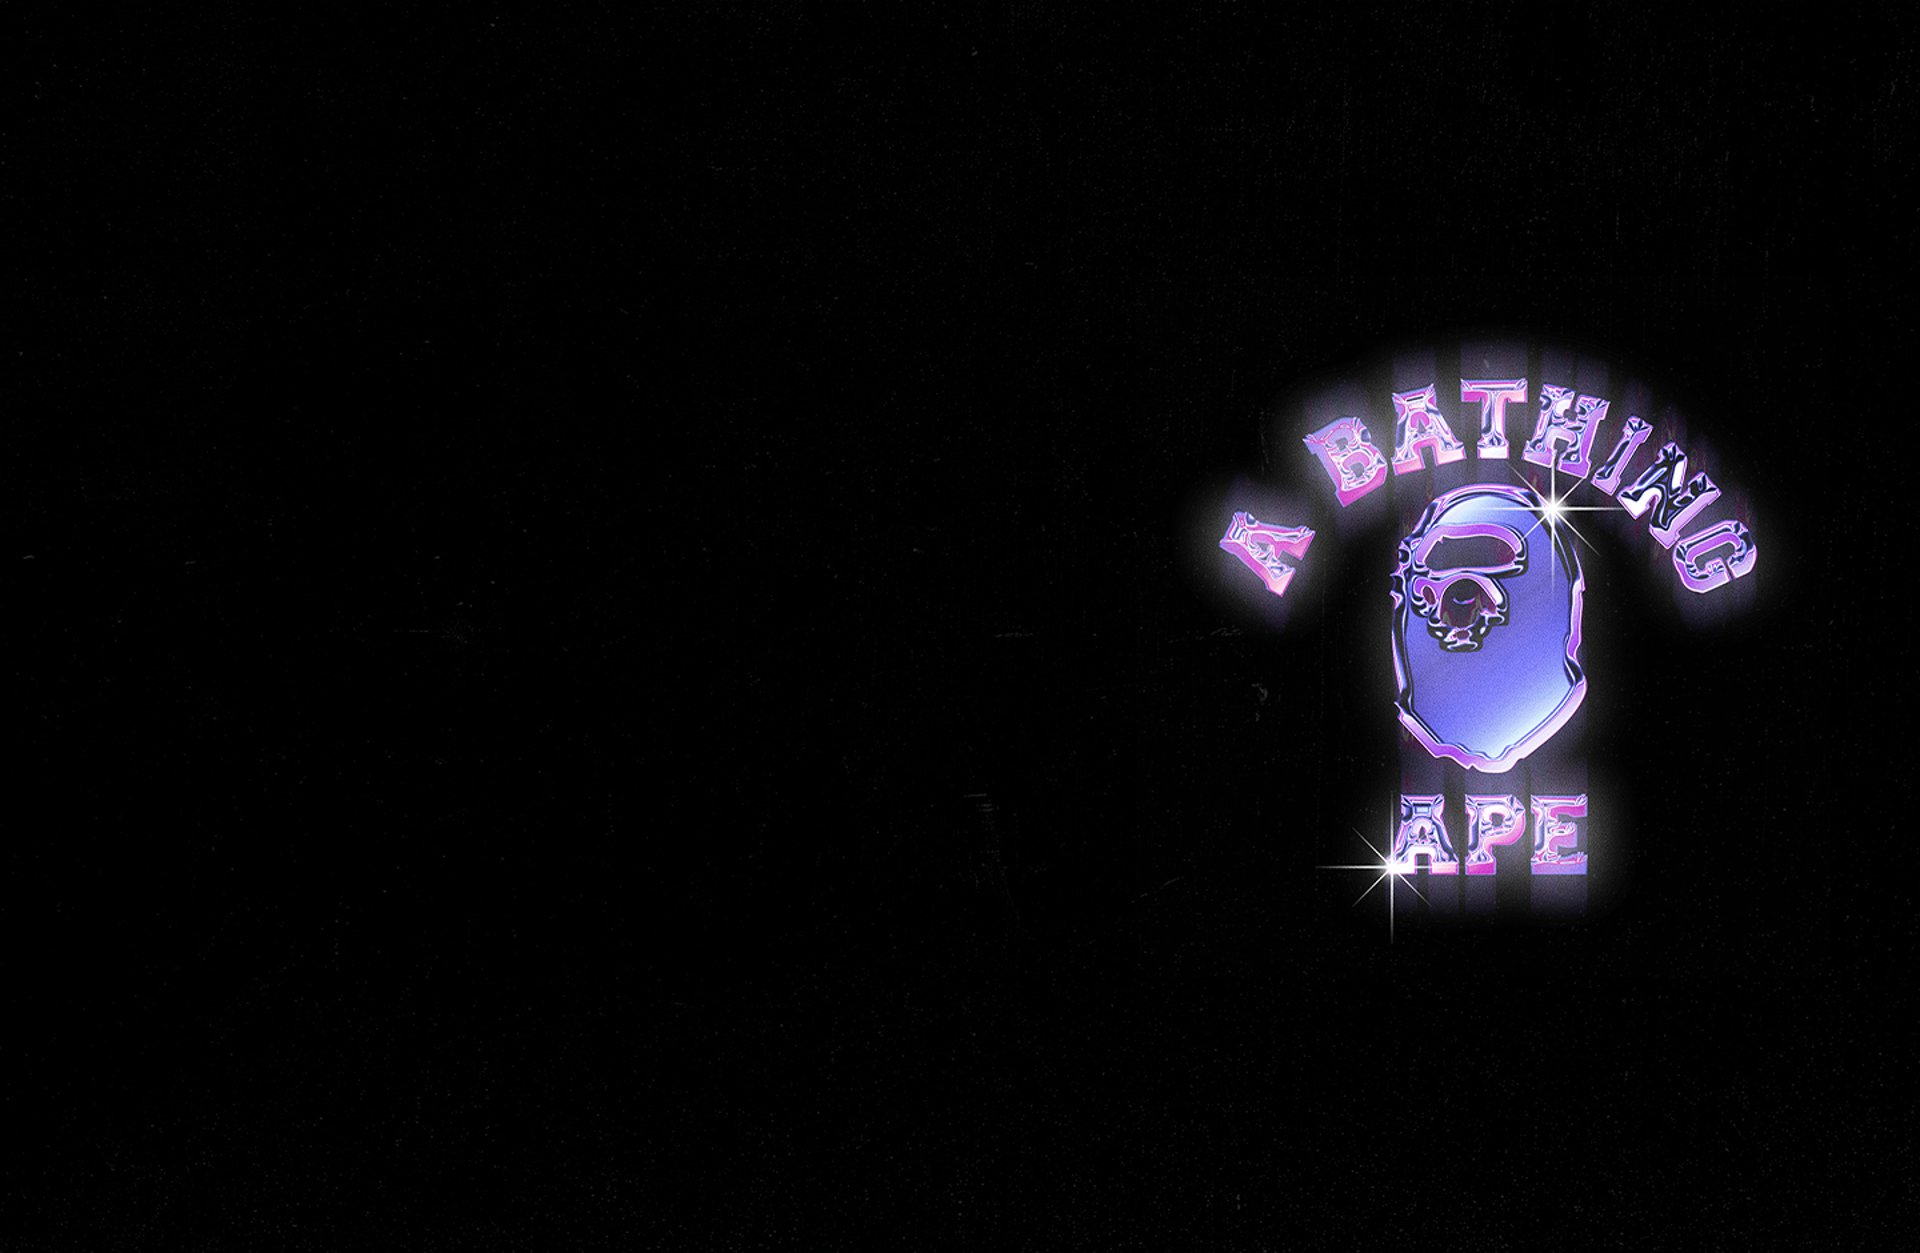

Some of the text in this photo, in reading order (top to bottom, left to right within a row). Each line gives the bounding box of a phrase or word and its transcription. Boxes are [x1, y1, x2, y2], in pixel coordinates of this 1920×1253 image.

[1219, 378, 1758, 597] A BATHING
[1389, 794, 1589, 876] APE
